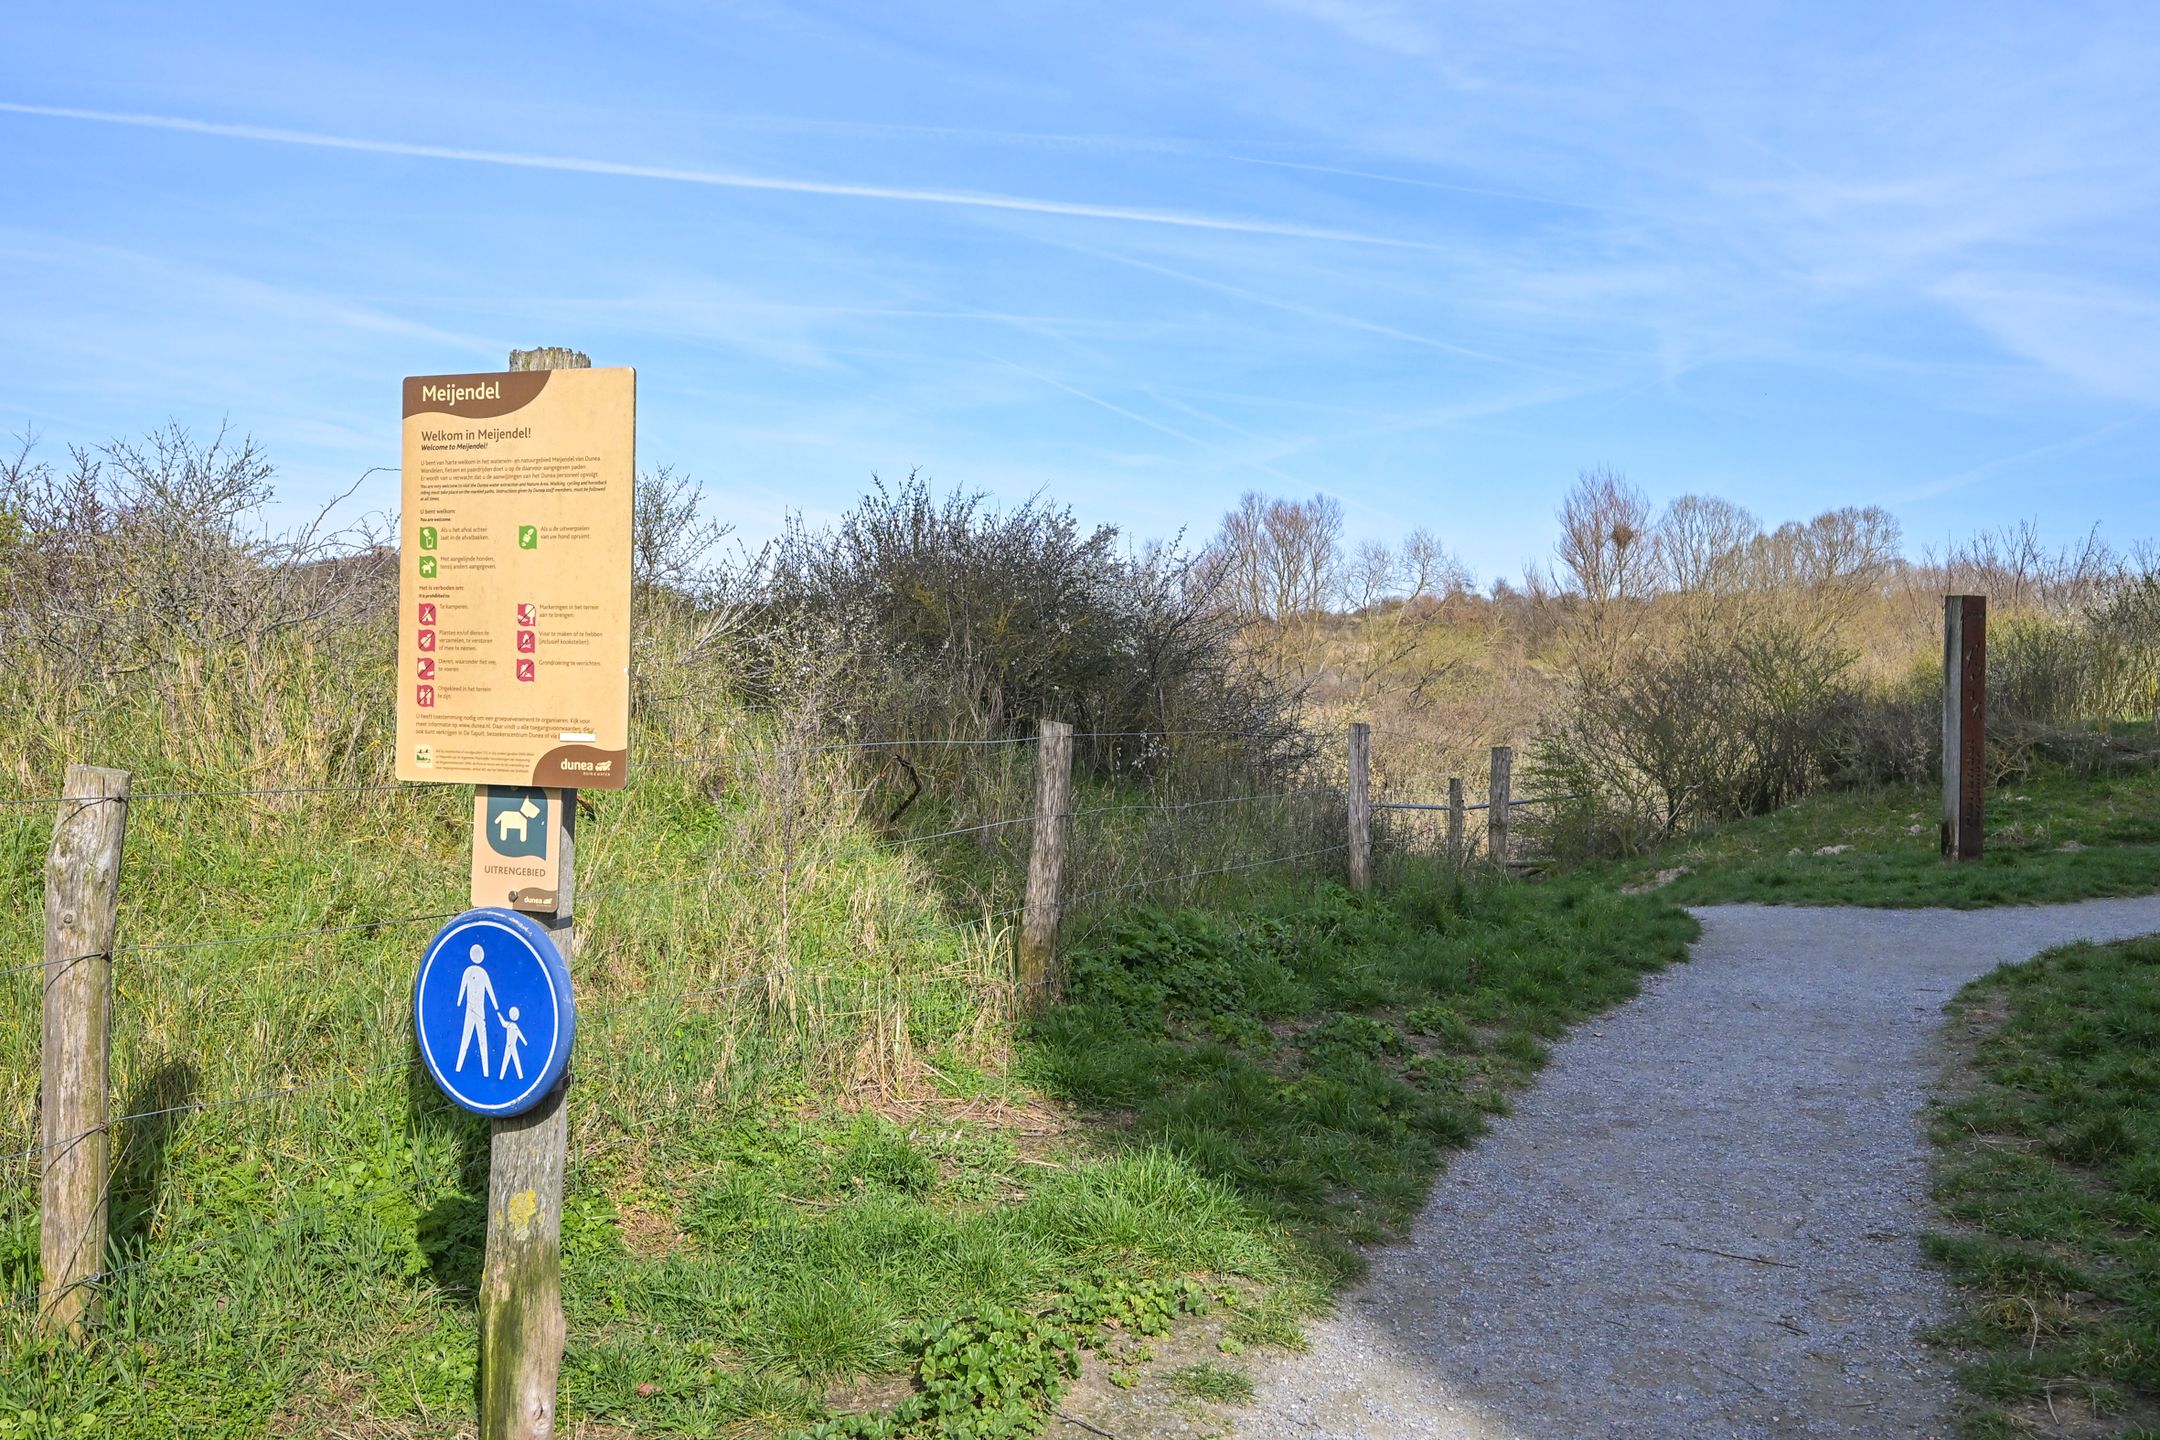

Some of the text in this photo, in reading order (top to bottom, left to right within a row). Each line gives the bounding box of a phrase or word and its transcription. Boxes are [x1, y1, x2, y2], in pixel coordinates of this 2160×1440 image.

[422, 381, 500, 406] Meijendel
[421, 427, 531, 442] Welkom in Meijendel!
[456, 443, 488, 451] Meijendel!
[561, 758, 593, 771] dunea
[484, 865, 546, 877] UITRENGEBIED
[524, 896, 542, 904] dunea
